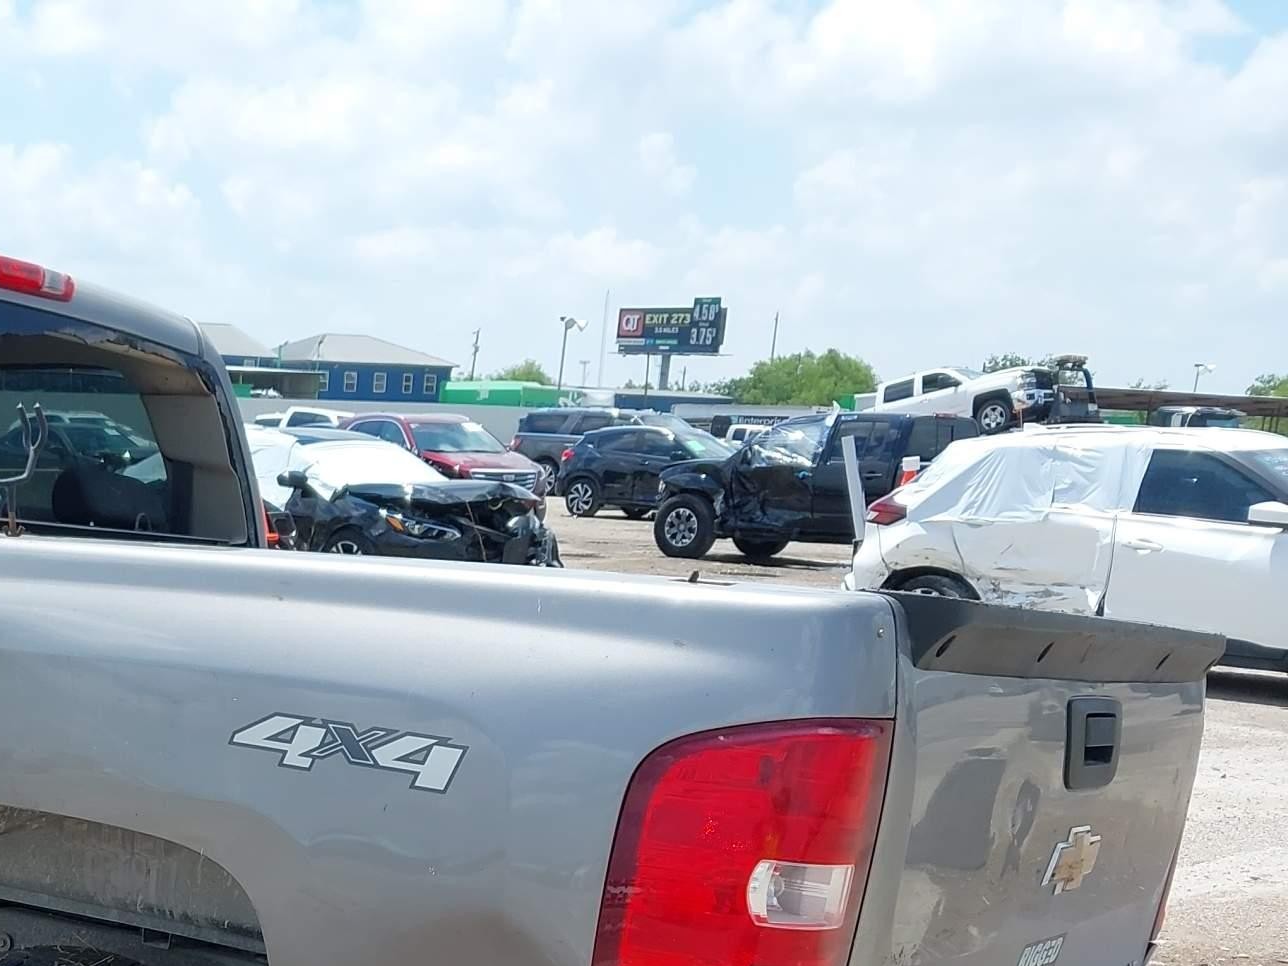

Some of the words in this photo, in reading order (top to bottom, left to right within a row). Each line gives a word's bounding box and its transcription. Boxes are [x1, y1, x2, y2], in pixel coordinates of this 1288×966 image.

[622, 314, 640, 332] QT
[645, 314, 668, 324] EXIT
[670, 313, 691, 324] 273
